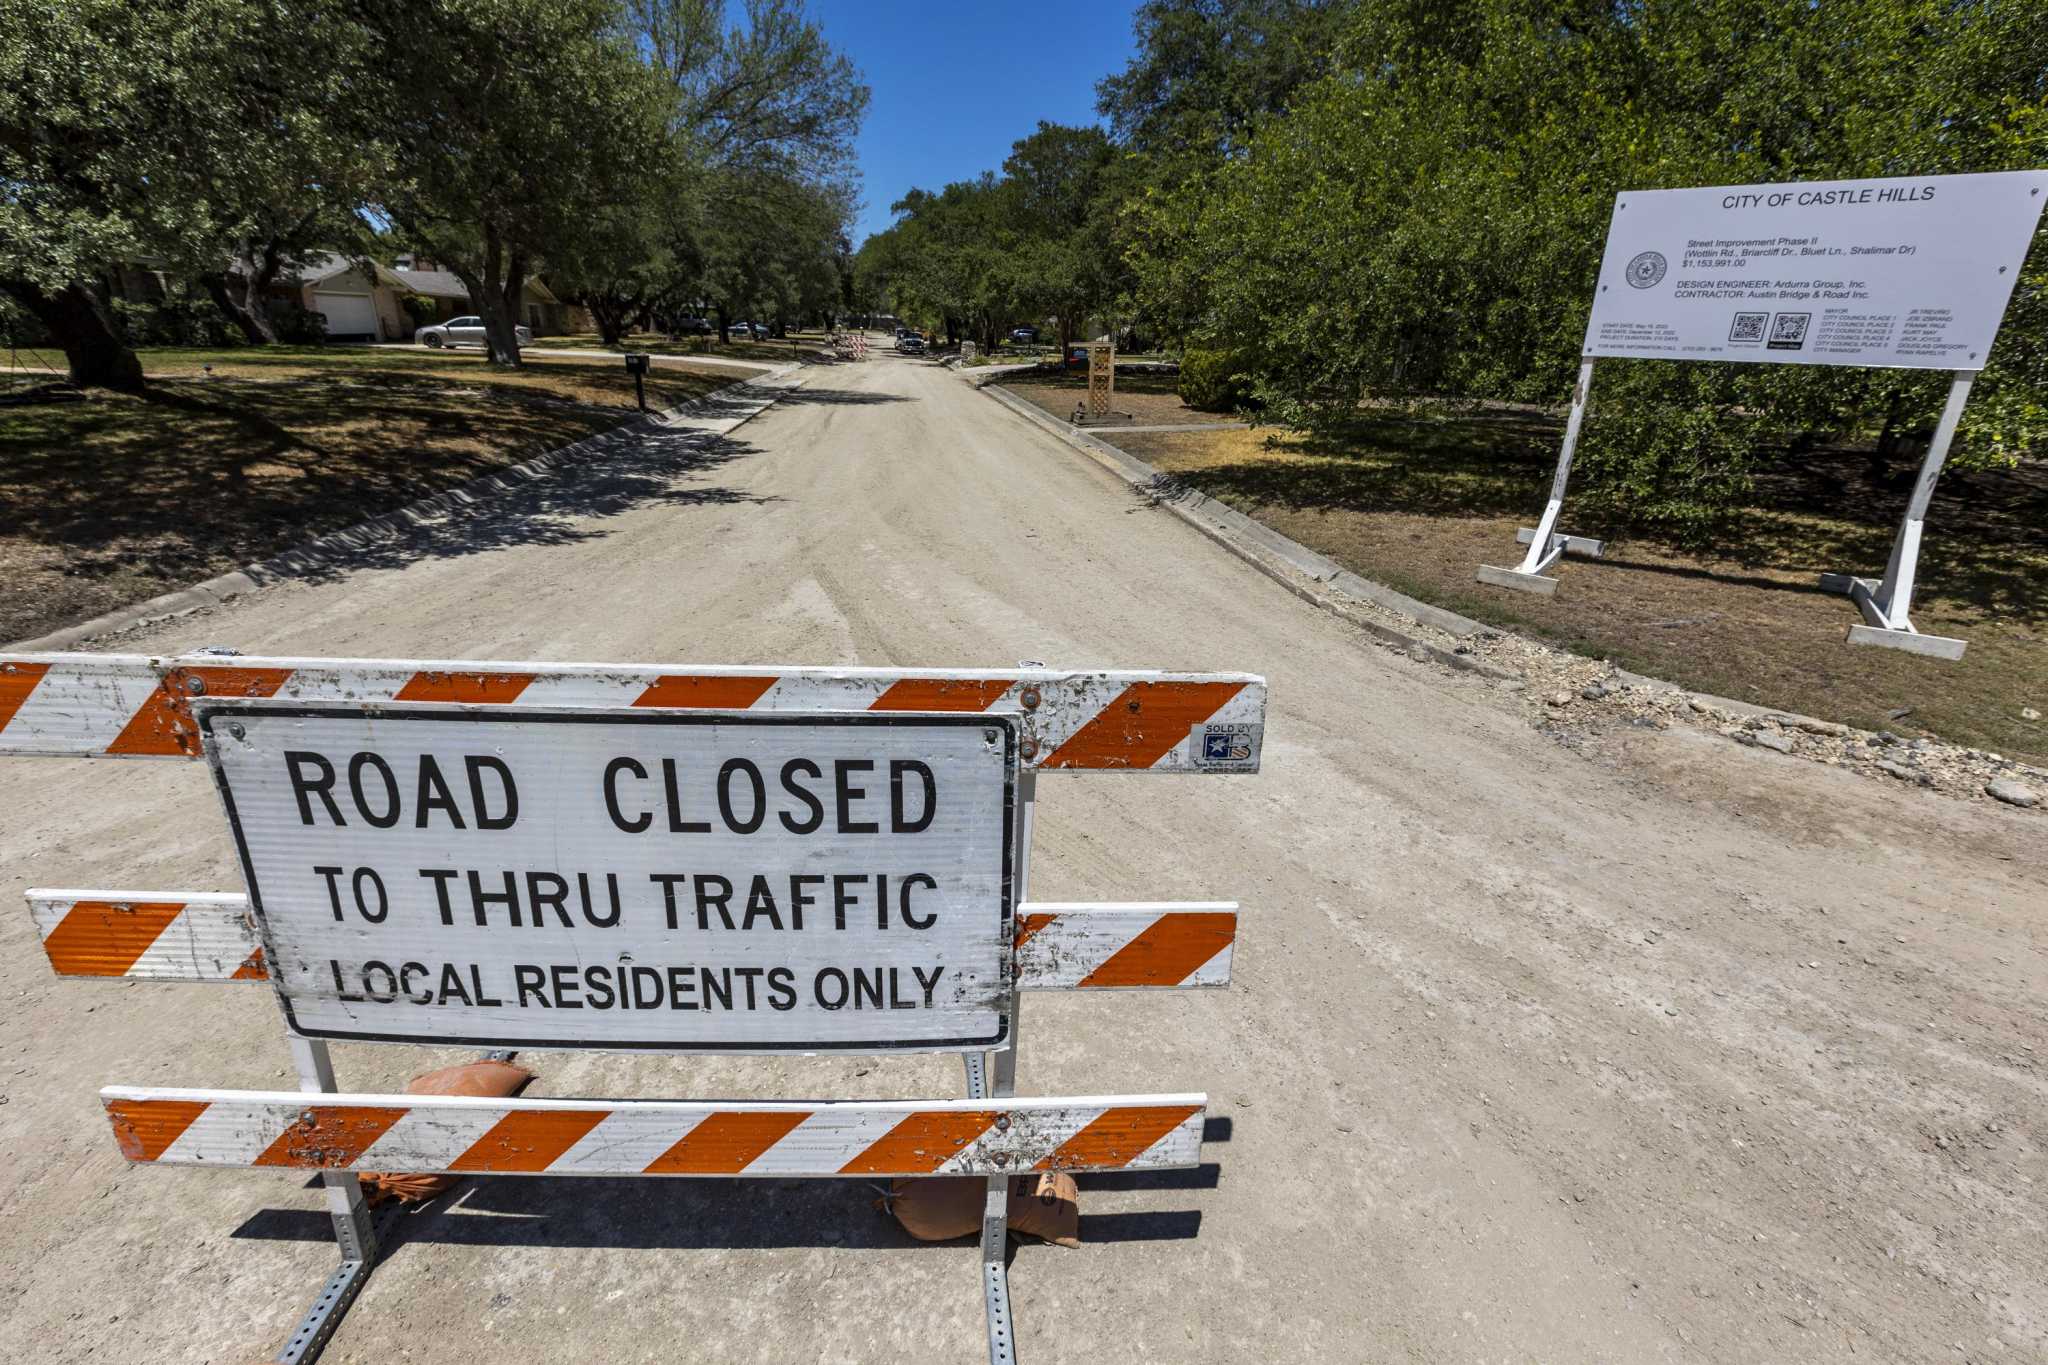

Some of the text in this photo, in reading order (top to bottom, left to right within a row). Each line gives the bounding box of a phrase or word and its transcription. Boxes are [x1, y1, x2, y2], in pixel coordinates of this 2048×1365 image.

[1722, 185, 1936, 209] CITY OF CASTLE HILLS
[1687, 239, 1714, 248] Street
[1715, 238, 1775, 248] Improvement
[1777, 237, 1809, 246] Phase
[1683, 248, 1719, 259] (Wottlin
[1741, 247, 1780, 257] Briarcliff
[1800, 246, 1827, 256] Bluet
[1850, 245, 1897, 256] Shalimar
[1898, 244, 1917, 256] Dr)
[1682, 258, 1747, 269] $1,153,991.00
[1676, 280, 1715, 289] DESIGN
[1716, 280, 1772, 289] ENGINEER:
[1773, 279, 1810, 289] Ardurra
[1848, 279, 1867, 289] Inc.
[1674, 290, 1745, 299] CONTRACTOR:
[1747, 290, 1777, 299] Austin
[1778, 290, 1811, 301] Bridge
[1811, 290, 1821, 299] &
[1822, 289, 1851, 299] Road
[1206, 724, 1235, 733] SOLD
[284, 750, 937, 835] ROAD CLOSED
[313, 866, 938, 930] TO THRU TRAFFIC
[329, 959, 945, 1011] LOCAL RESIDENTS ONLY
